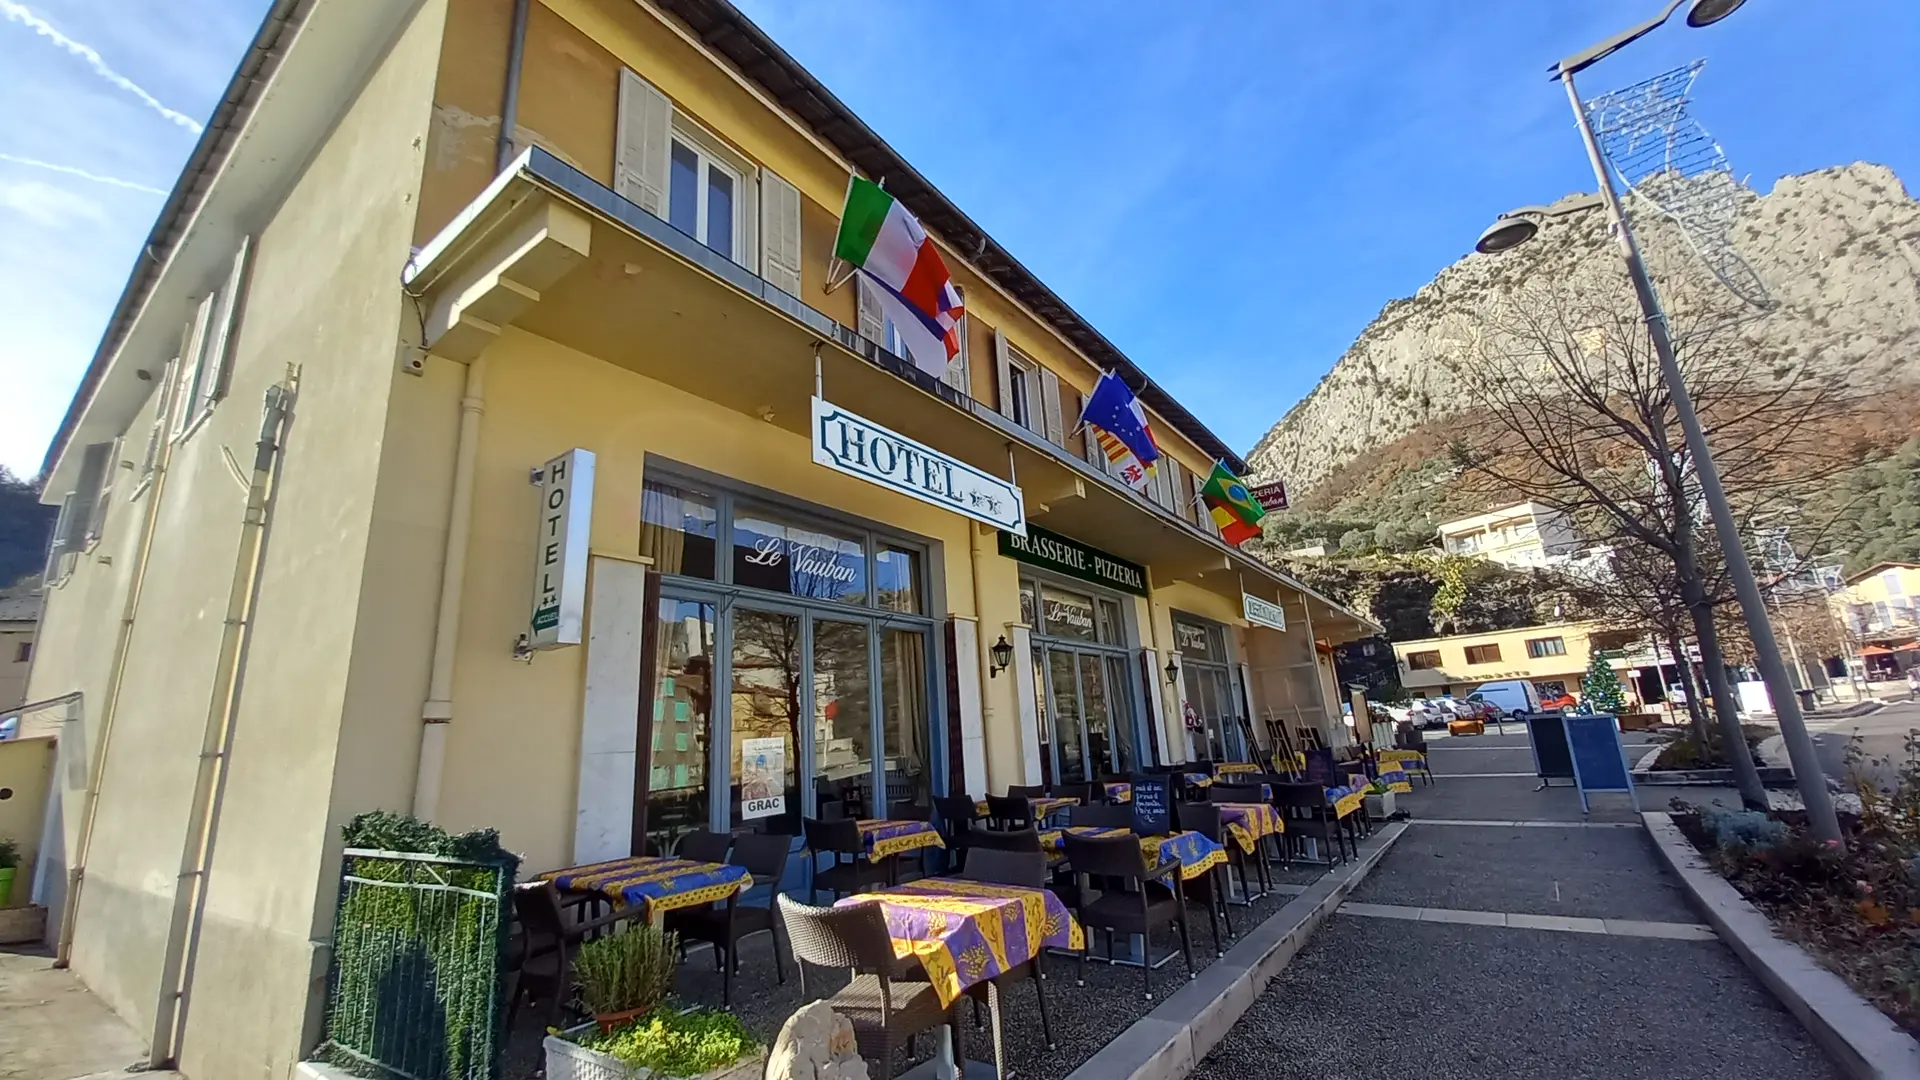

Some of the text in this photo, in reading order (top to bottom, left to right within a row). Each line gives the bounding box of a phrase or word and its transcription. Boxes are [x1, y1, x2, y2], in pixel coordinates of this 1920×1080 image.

[838, 420, 965, 504] HOTEL
[1251, 485, 1281, 499] ZERIA
[543, 461, 566, 594] HOTEL
[745, 537, 857, 583] Le Vauban
[1010, 534, 1086, 570] BRASSERIE
[1094, 556, 1143, 589] PIZZERIA
[1063, 604, 1093, 628] Vauban
[748, 797, 780, 812] GRAC
